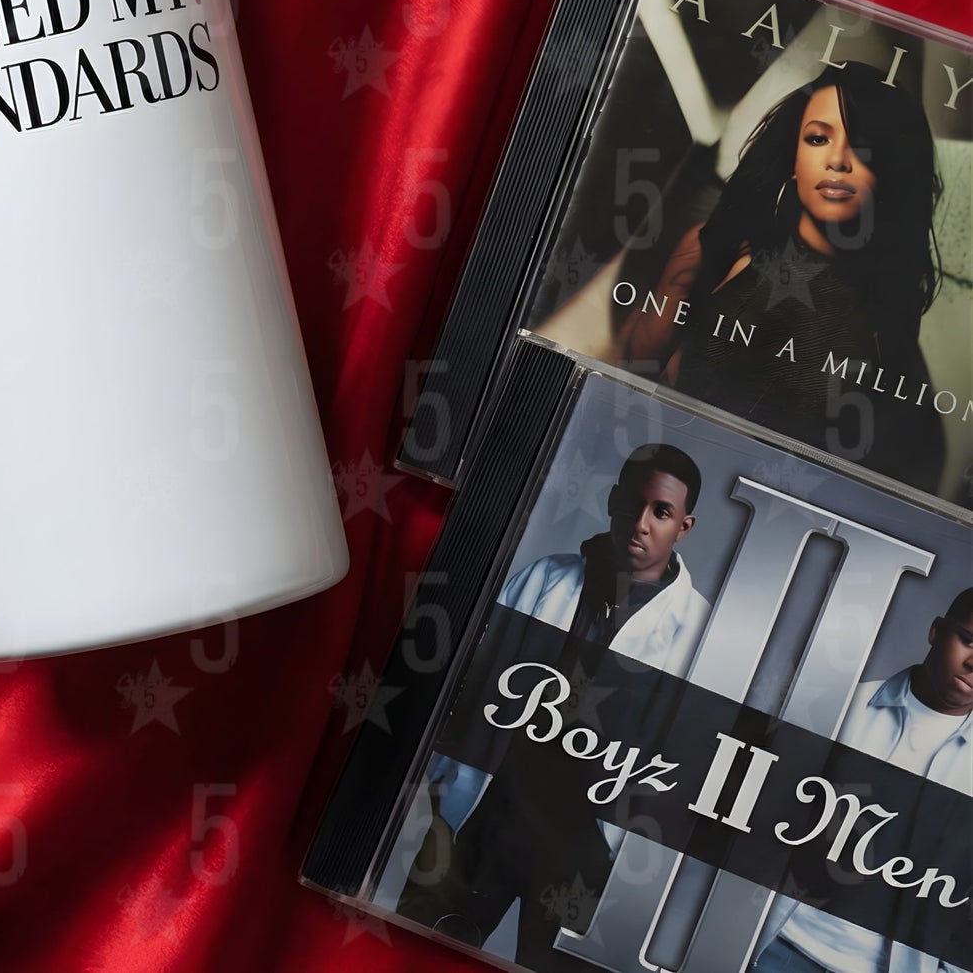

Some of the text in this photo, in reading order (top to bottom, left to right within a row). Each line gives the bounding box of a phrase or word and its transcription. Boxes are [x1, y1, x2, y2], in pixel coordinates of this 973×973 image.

[612, 281, 691, 325] ONE
[712, 314, 757, 347] IN
[774, 337, 797, 362] A
[483, 662, 969, 908] Boyz II Men
